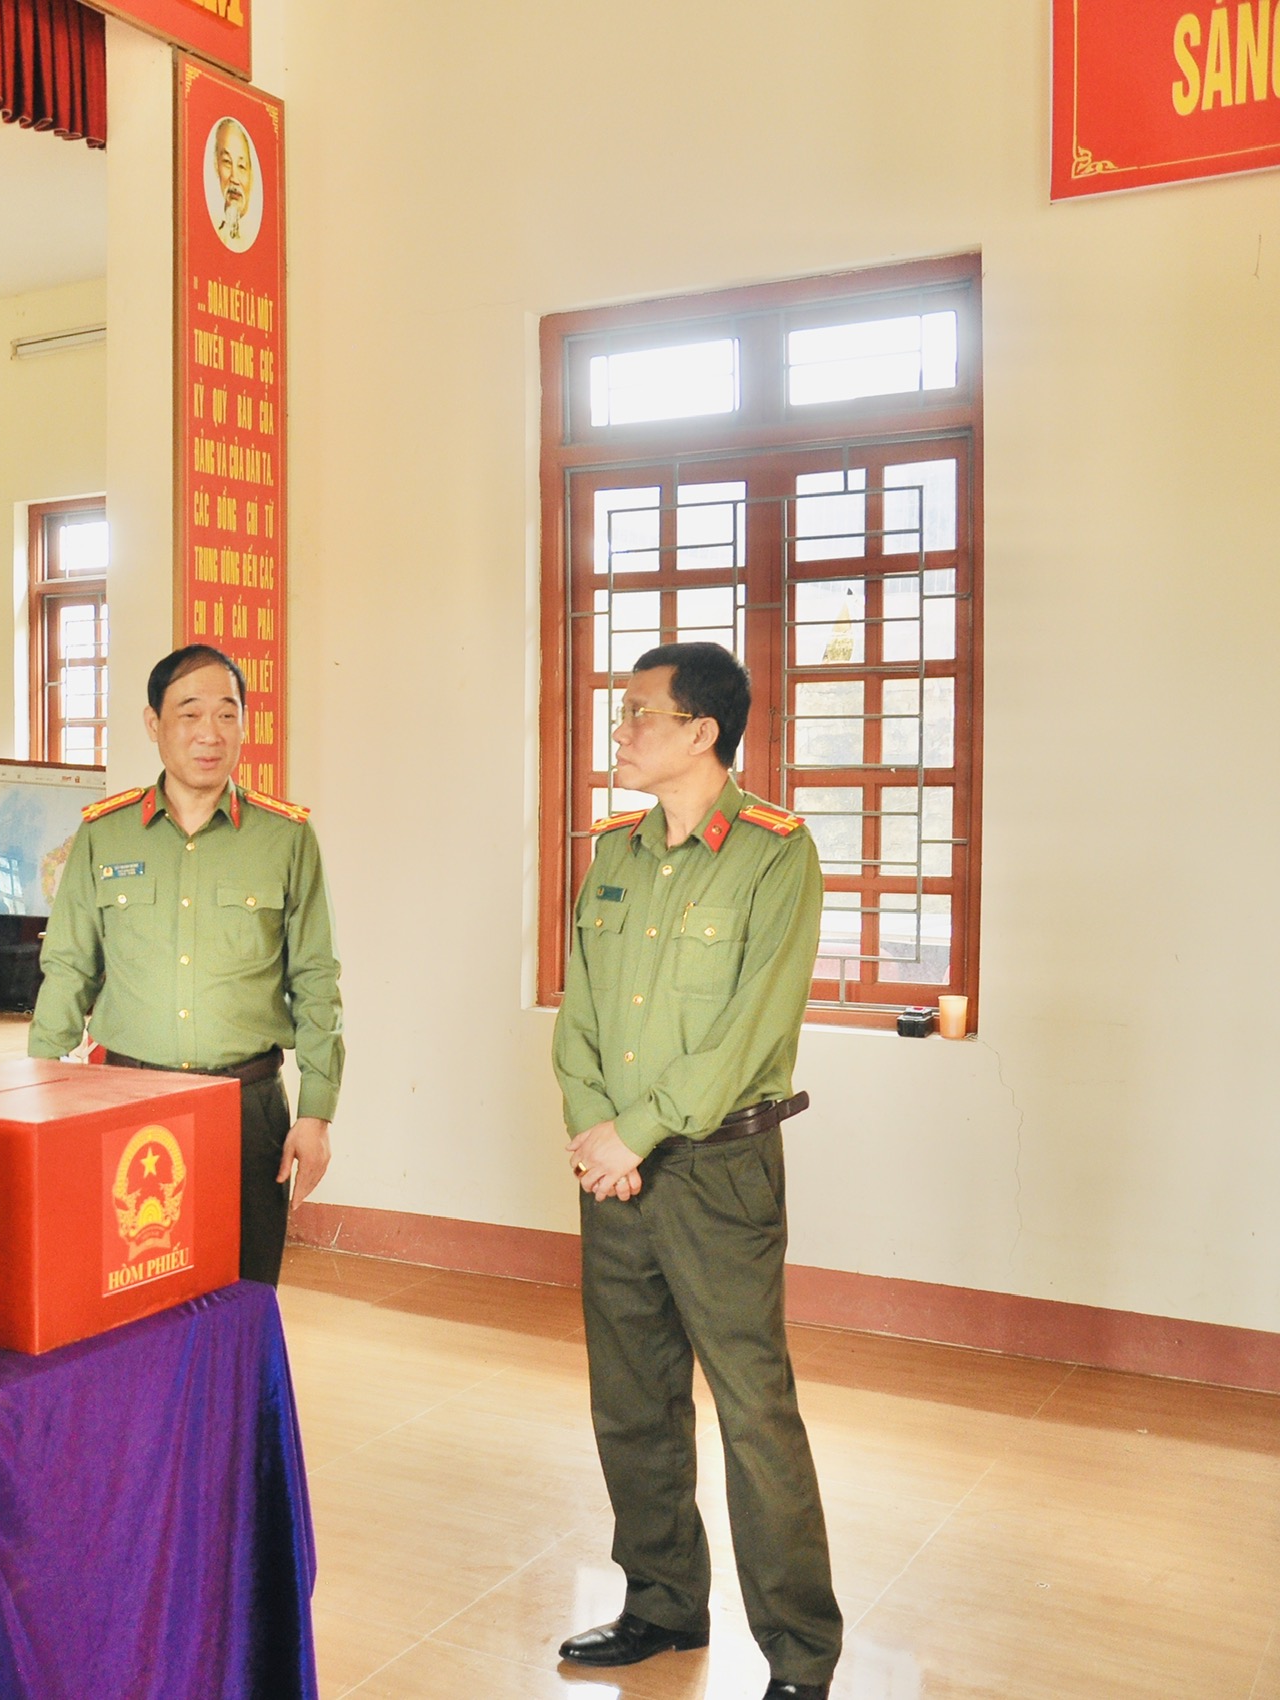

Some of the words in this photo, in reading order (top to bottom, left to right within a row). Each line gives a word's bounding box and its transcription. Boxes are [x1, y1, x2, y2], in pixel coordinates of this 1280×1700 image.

[1172, 0, 1280, 116] SÁN
[230, 280, 245, 324] KẾT
[246, 287, 256, 328] LÀ
[193, 377, 205, 419] KỲ
[217, 436, 227, 477] VÀ
[194, 485, 209, 528] CÁC
[194, 546, 218, 584] TRUNG
[260, 550, 274, 590] CÁC
[194, 599, 207, 635] CHI
[259, 651, 274, 693] KẾT
[108, 1263, 144, 1291] HÒM
[147, 1241, 190, 1278] PHIẾU
